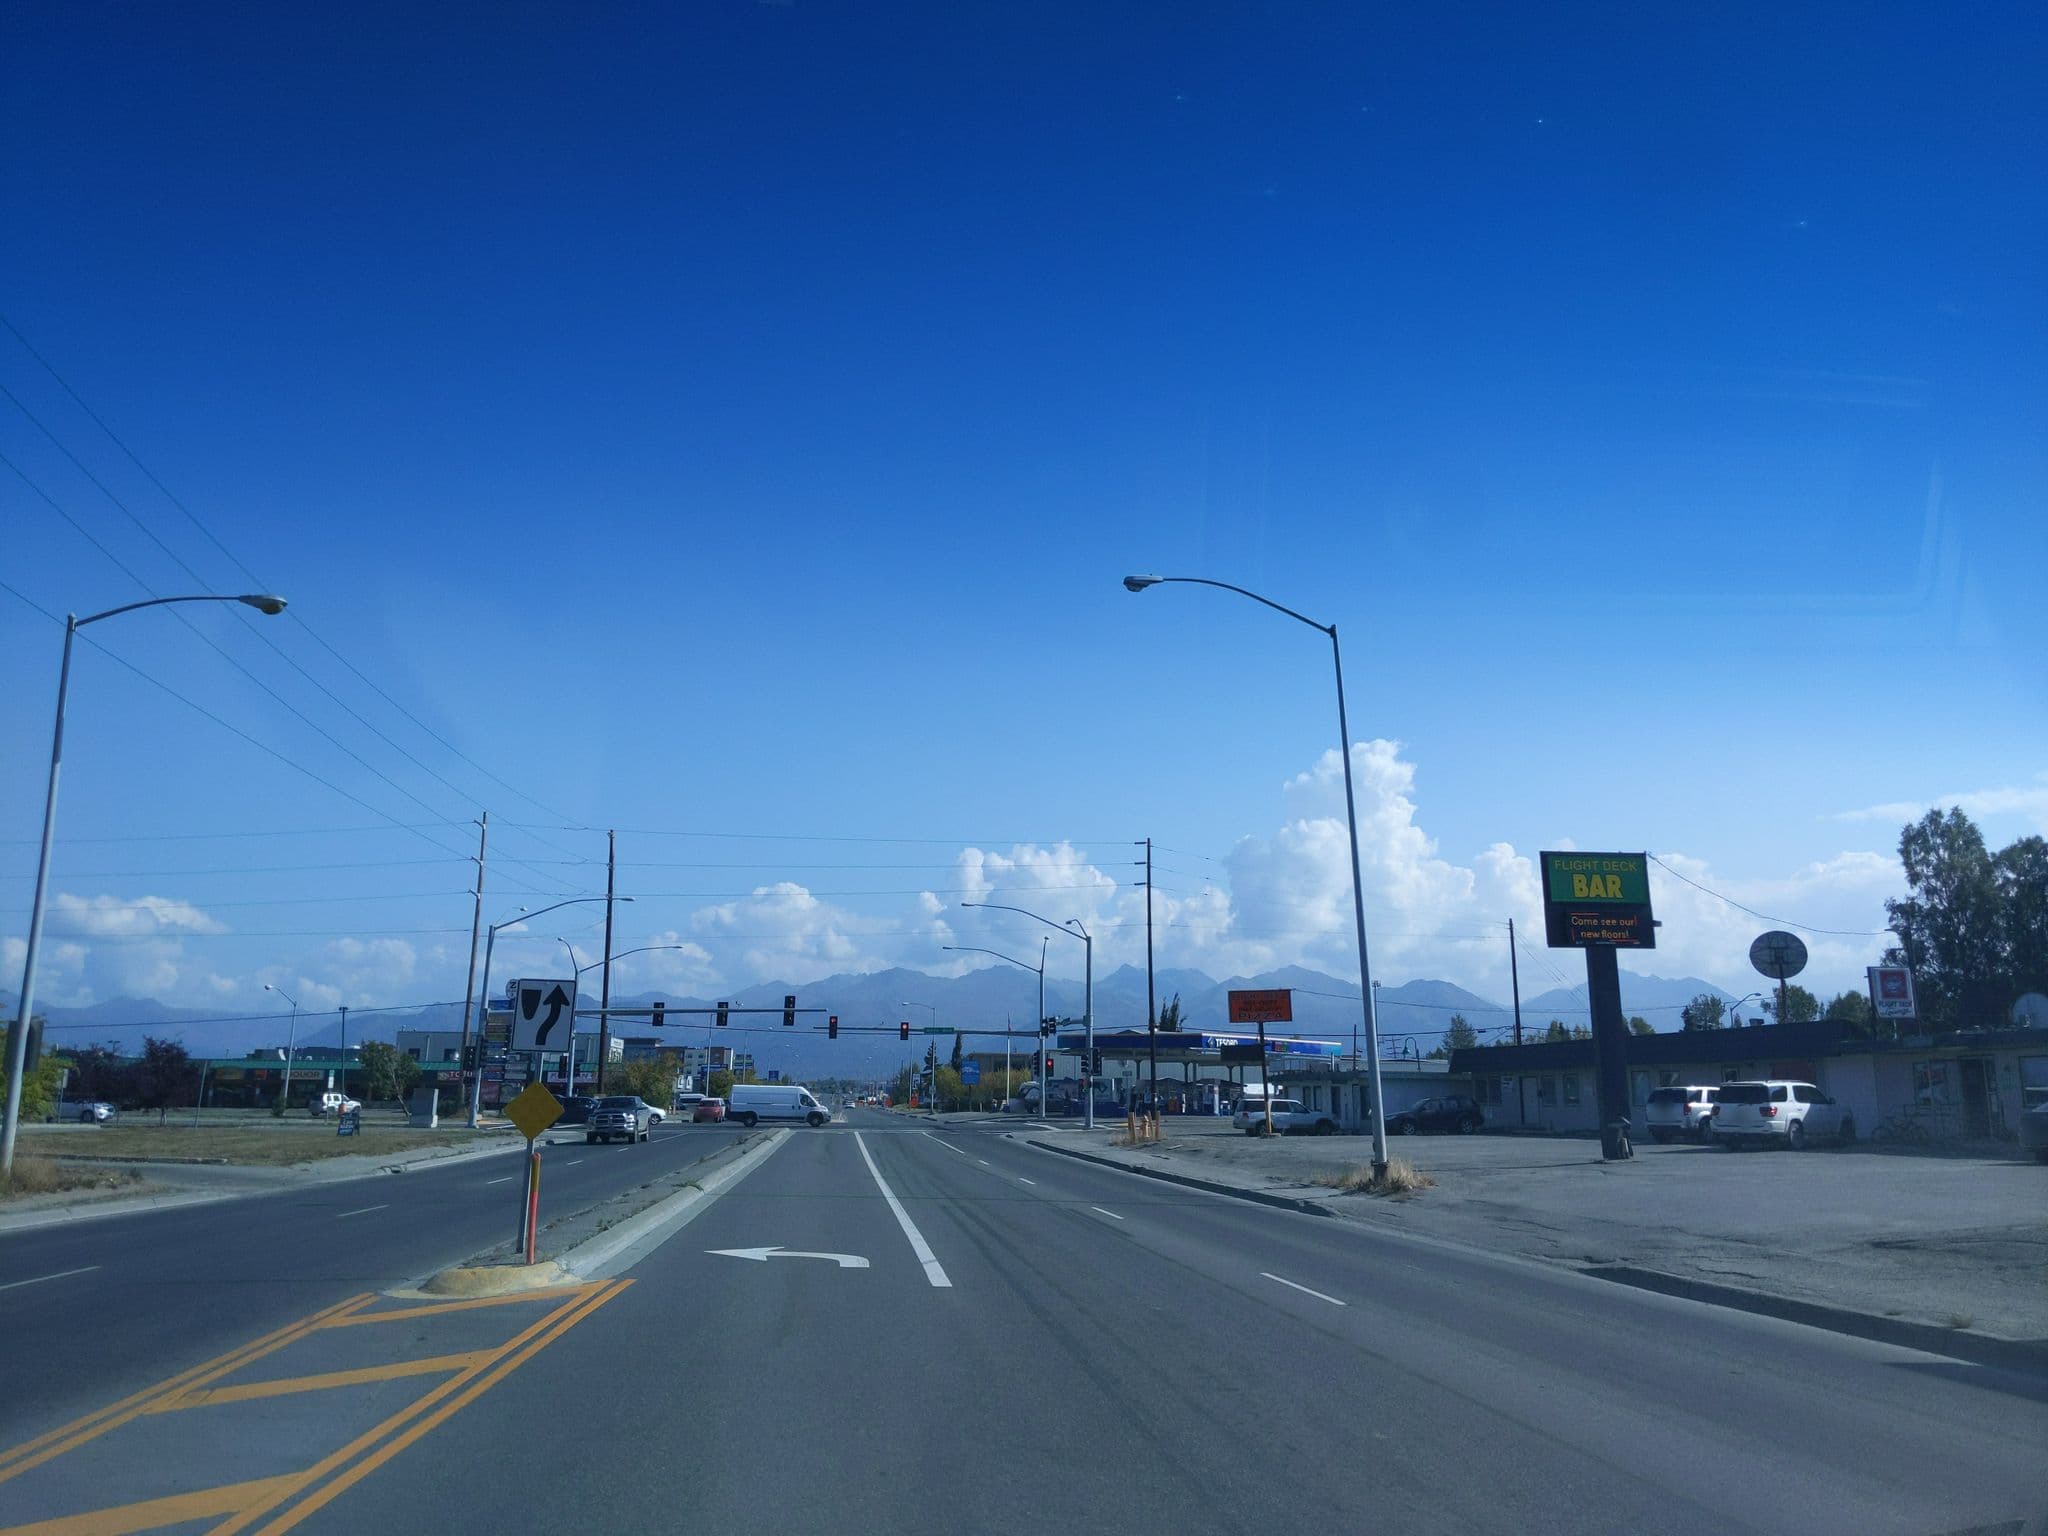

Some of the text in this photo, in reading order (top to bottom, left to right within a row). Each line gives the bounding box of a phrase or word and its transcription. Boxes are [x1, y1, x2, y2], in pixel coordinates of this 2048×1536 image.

[1554, 860, 1638, 872] FLIGHT DECK
[1572, 873, 1624, 899] BAR
[1571, 916, 1635, 926] Come see our
[1580, 931, 1600, 939] new
